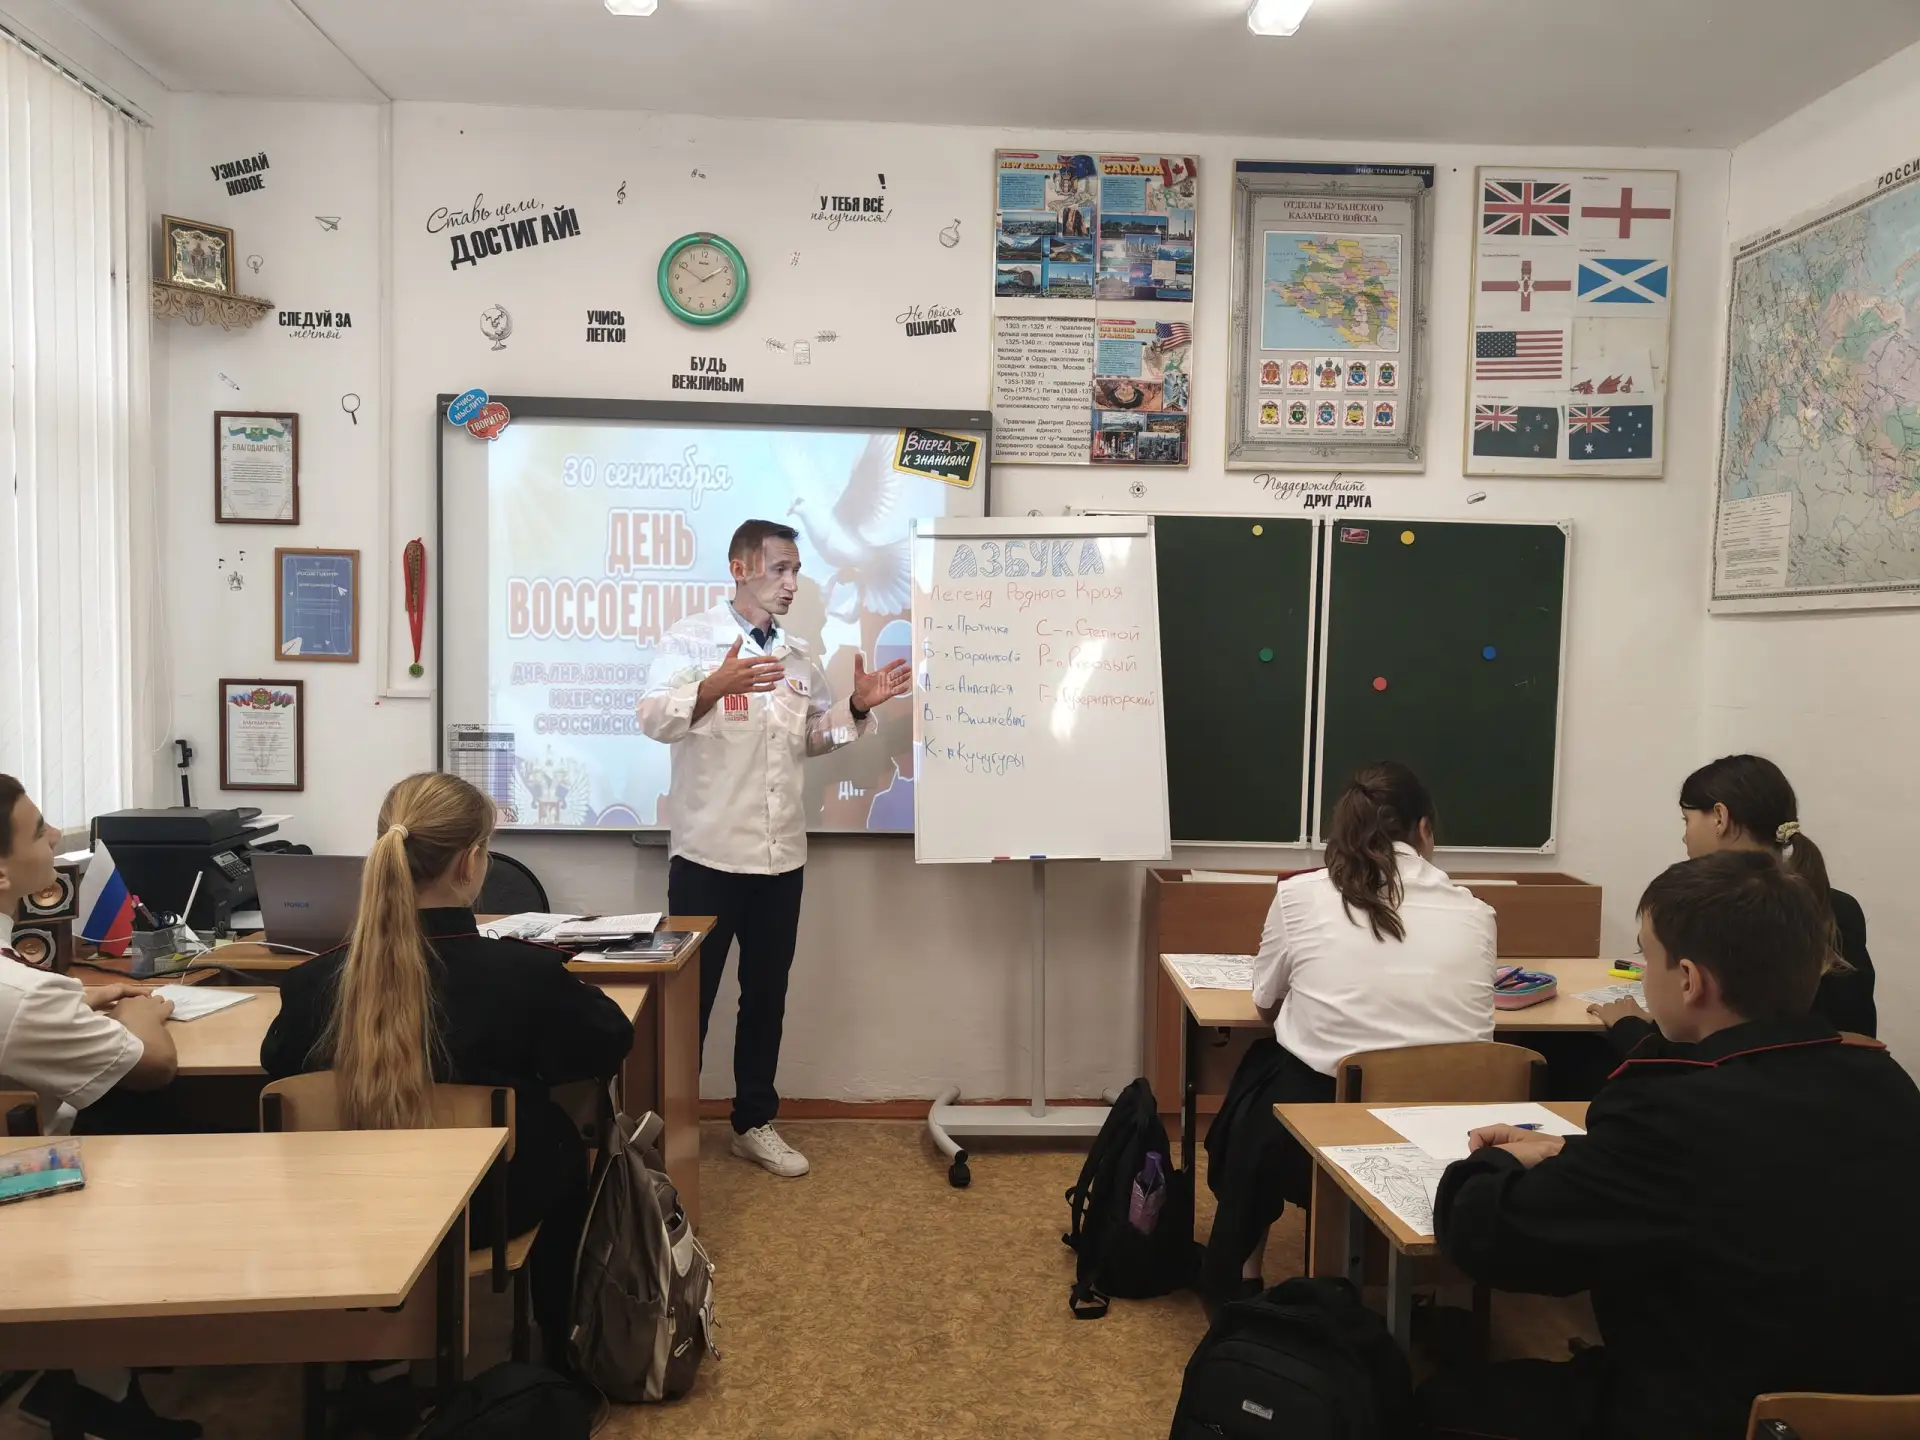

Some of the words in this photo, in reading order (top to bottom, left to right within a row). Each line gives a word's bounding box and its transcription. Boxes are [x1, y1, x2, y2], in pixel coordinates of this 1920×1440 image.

[211, 152, 270, 181] УЗНАВАЙ
[1102, 163, 1164, 175] CANADA
[1878, 159, 1920, 189] РОССИ
[226, 174, 265, 196] НОВОЕ
[426, 193, 492, 233] Ставь
[495, 198, 545, 222] цели,
[820, 196, 828, 211] У
[832, 196, 860, 212] ТЕБЯ
[863, 196, 884, 213] ВСЁ
[1283, 200, 1321, 209] ОТДЕЛЫ
[1325, 202, 1384, 212] КУБАНСКОГО
[810, 208, 893, 231] получится!
[1288, 212, 1340, 221] КАЗАЧЬЕГО
[1342, 213, 1378, 223] ВОЙСКА
[450, 205, 581, 271] ДОСТИГАЙ!
[279, 309, 332, 329] СЛЕДУЙ
[335, 312, 352, 328] ЗА
[587, 310, 625, 326] УЧИСЬ
[895, 305, 924, 324] Не
[928, 304, 963, 320] бойся
[289, 328, 342, 339] мечтой
[586, 328, 626, 343] ЛЕГКО!
[905, 318, 957, 337] ОШИБОК
[690, 356, 727, 375] БУДЬ
[671, 374, 744, 392] ВЕЖЛИВЫМ
[453, 393, 475, 411] УЧИСЬ
[454, 396, 486, 421] МЫСЛИТЬ
[469, 411, 508, 433] ТВОРИТЬ!
[232, 443, 283, 453] БЛАГОДАРНОСТЬ
[902, 454, 911, 466] К
[913, 454, 970, 467] ЗНАНИЯМ!
[563, 455, 597, 488] 30
[604, 444, 733, 510] сентября
[1253, 472, 1366, 500] Поддерживайте
[1303, 494, 1333, 509] ДРУГ
[1335, 495, 1372, 510] ДРУГА
[606, 508, 697, 577] ДЕНЬ
[949, 539, 1105, 579] АЗБУКА
[930, 585, 993, 610] Легенд
[1007, 581, 1066, 612] Родного
[1076, 580, 1124, 605] Края
[1076, 618, 1140, 641] Степной
[586, 662, 652, 685] ЗАПОРО
